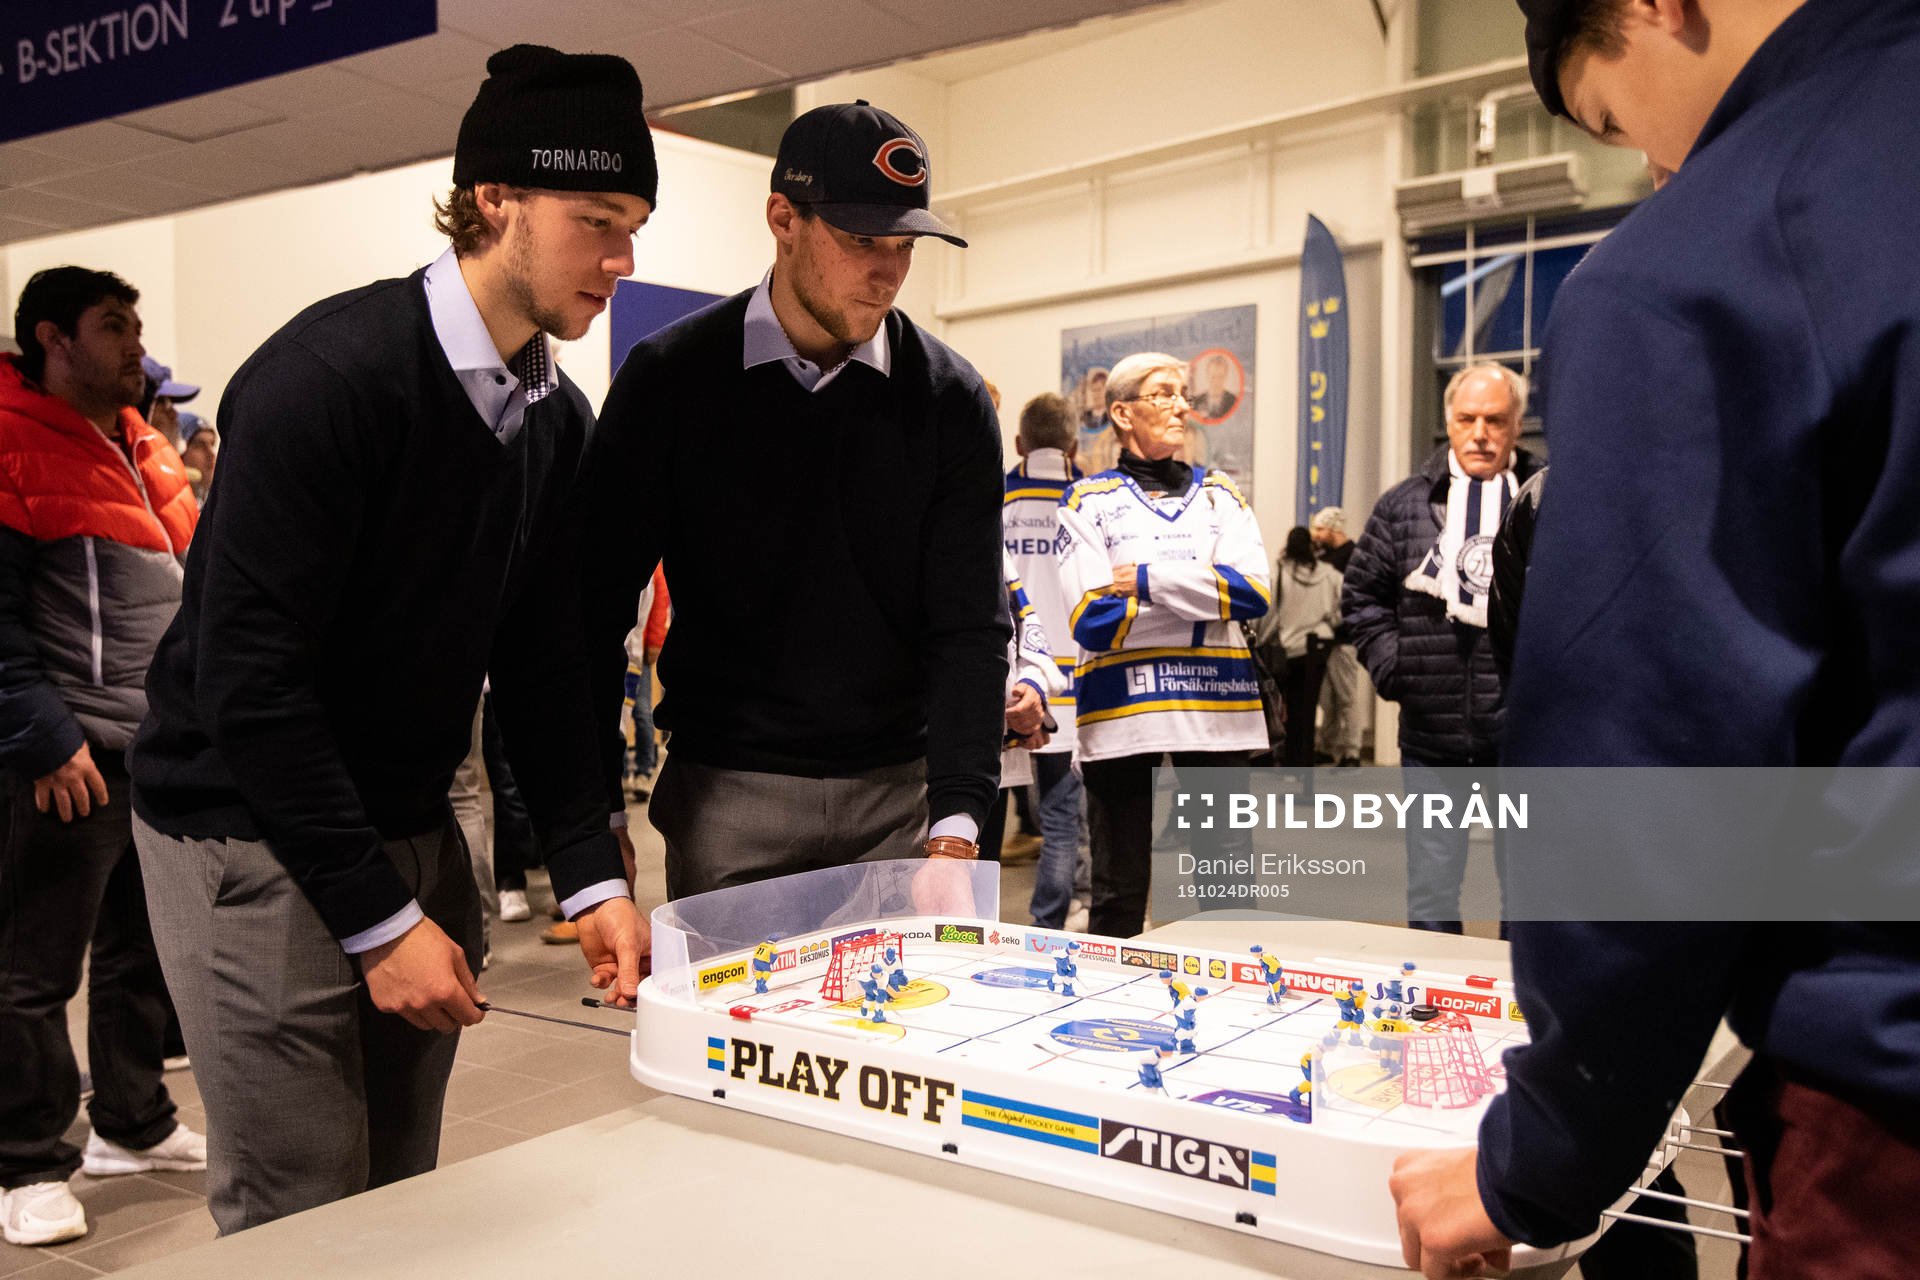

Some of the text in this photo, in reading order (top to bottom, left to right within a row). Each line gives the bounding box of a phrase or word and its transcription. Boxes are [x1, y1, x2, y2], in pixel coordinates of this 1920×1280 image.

[18, 0, 189, 83] B-SEKTION
[531, 148, 623, 173] TORNARDO
[873, 137, 927, 187] C
[1004, 516, 1056, 529] eksands
[1158, 662, 1219, 677] Dalarnas
[940, 925, 979, 944] Leca
[1002, 935, 1020, 946] seko
[702, 966, 745, 984] engcon
[1432, 995, 1493, 1014] LOOPIA
[730, 1037, 956, 1125] PLAY OFF
[1212, 1095, 1273, 1113] V75
[984, 1109, 996, 1118] THE
[1024, 1117, 1053, 1130] HOCKEY
[1054, 1123, 1076, 1135] GAME
[1105, 1127, 1245, 1187] STIGA
